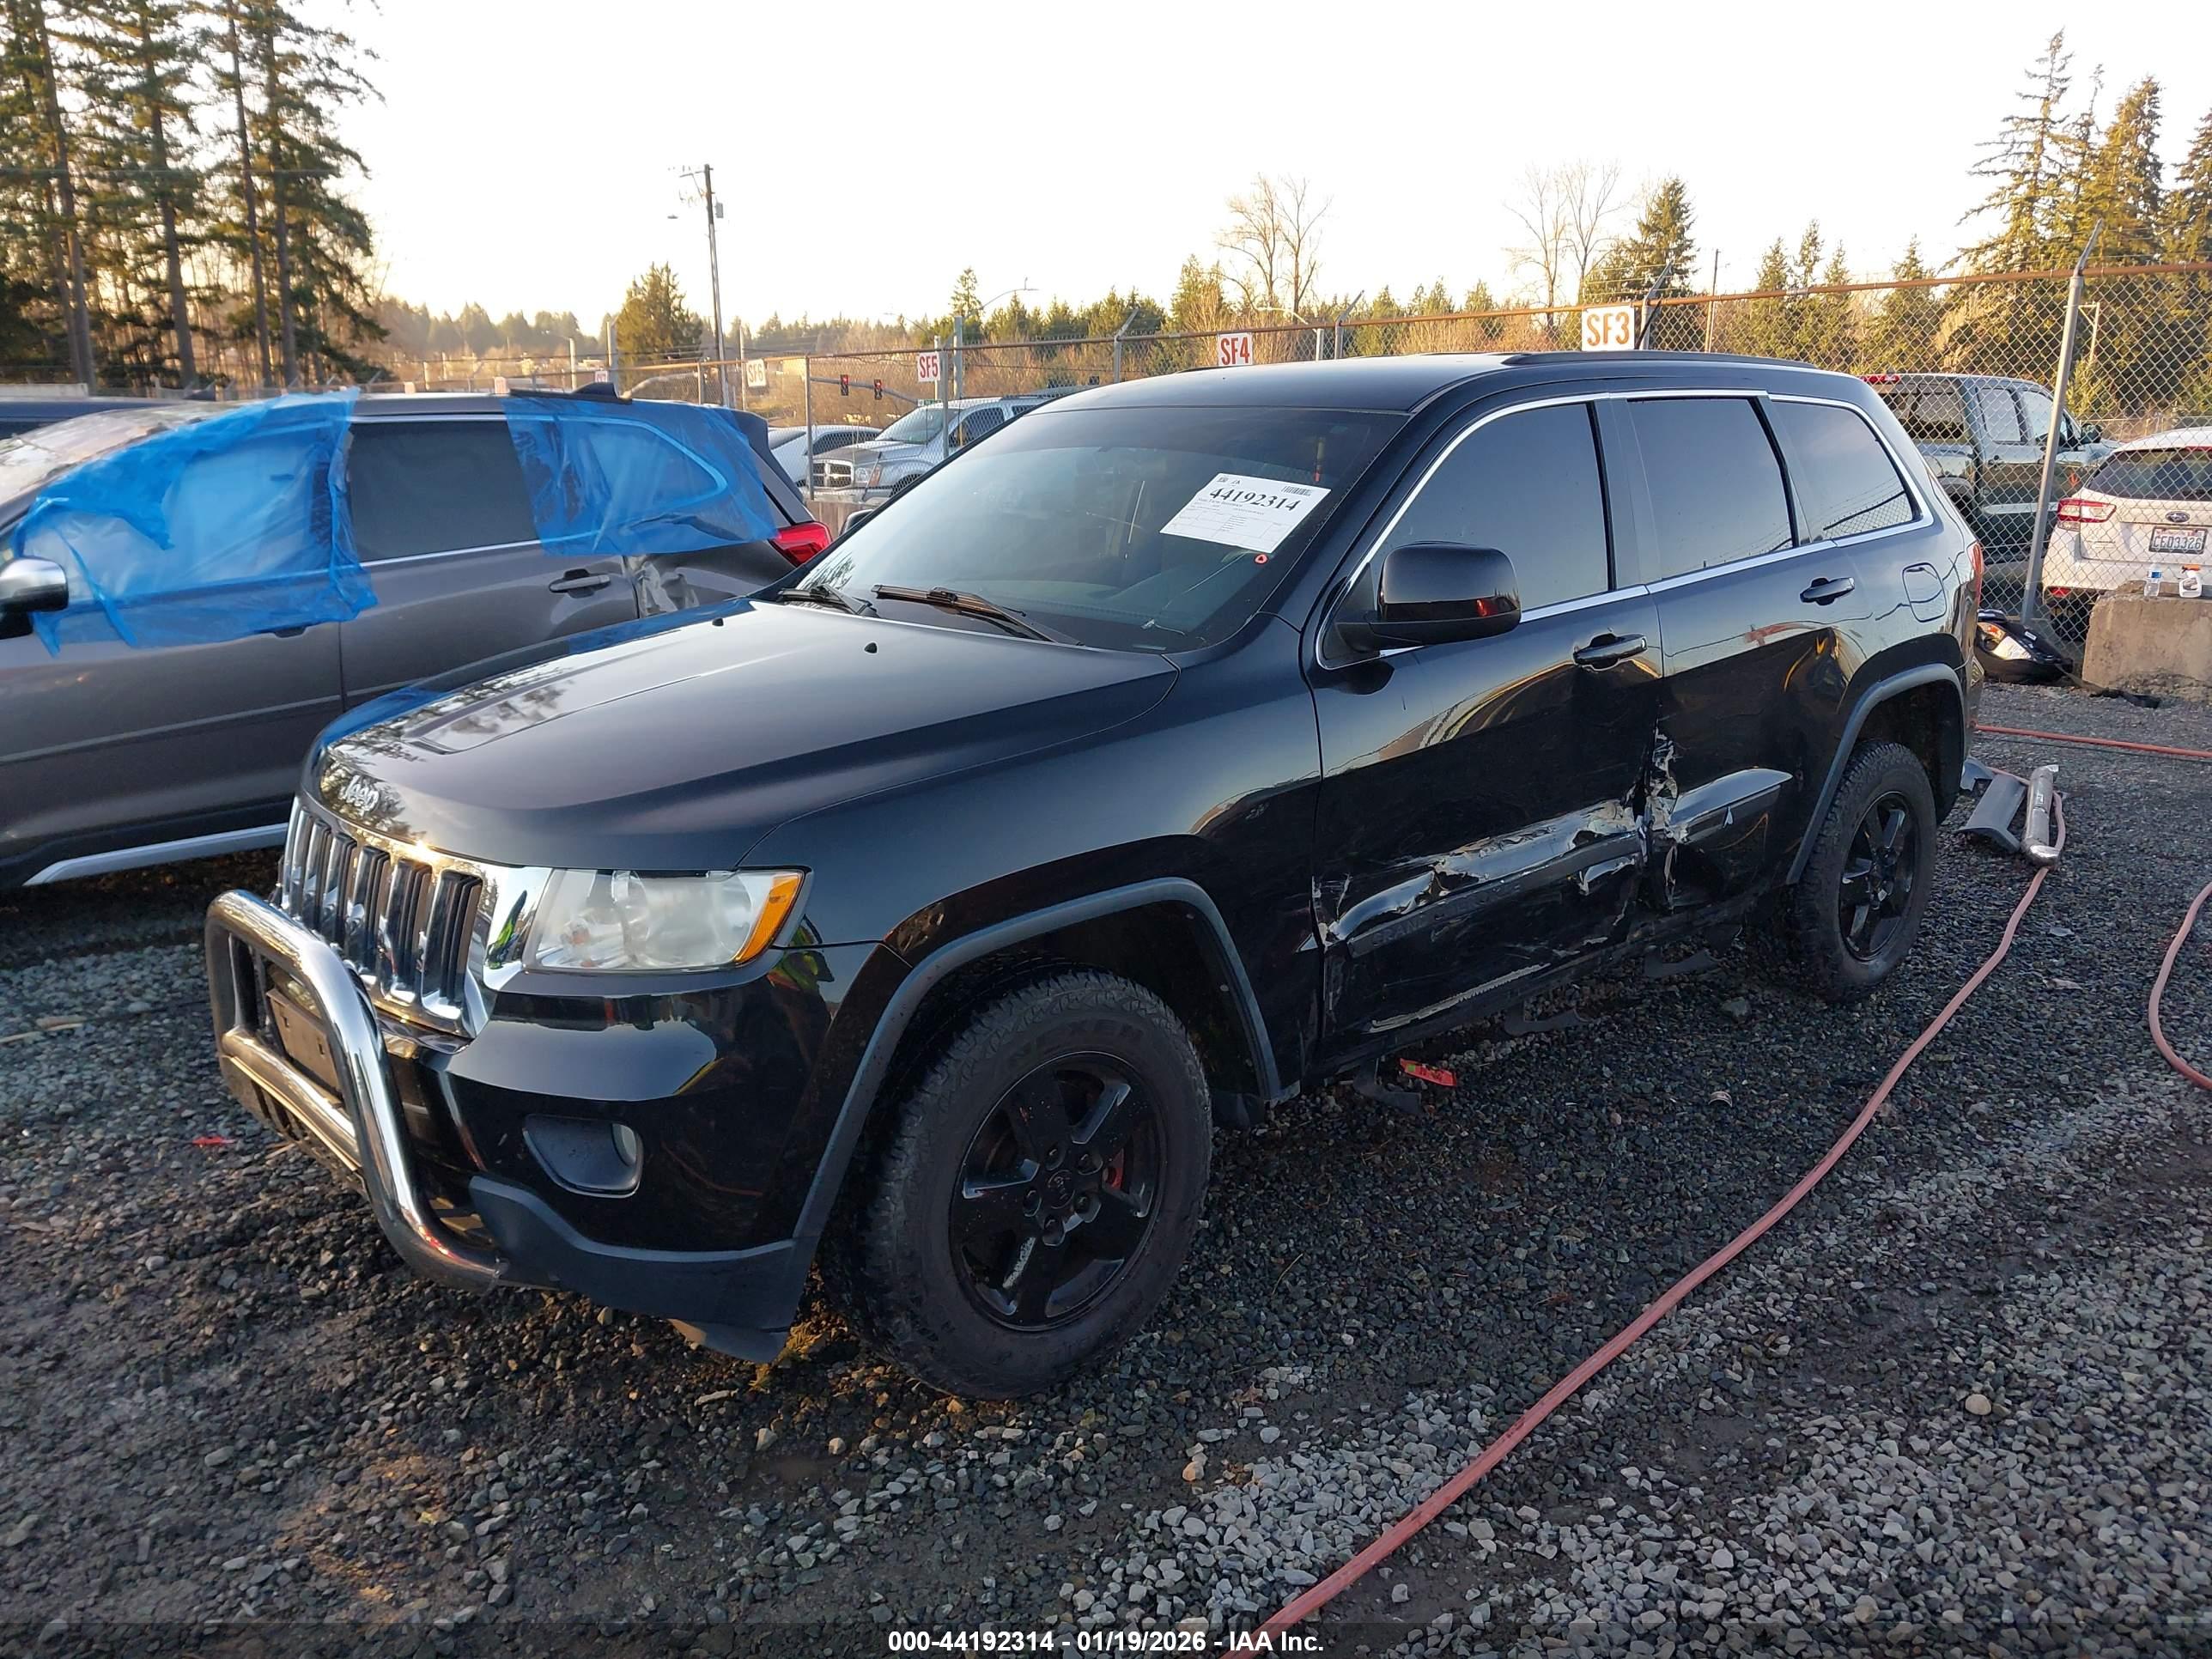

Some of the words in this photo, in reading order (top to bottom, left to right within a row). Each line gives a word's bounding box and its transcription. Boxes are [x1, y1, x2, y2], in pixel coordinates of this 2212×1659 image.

[1586, 311, 1630, 347] SF3
[1220, 336, 1250, 366] SF4
[748, 363, 763, 383] SF6
[919, 356, 939, 379] SF5
[1209, 487, 1301, 512] 44192314
[338, 775, 380, 817] Jeep
